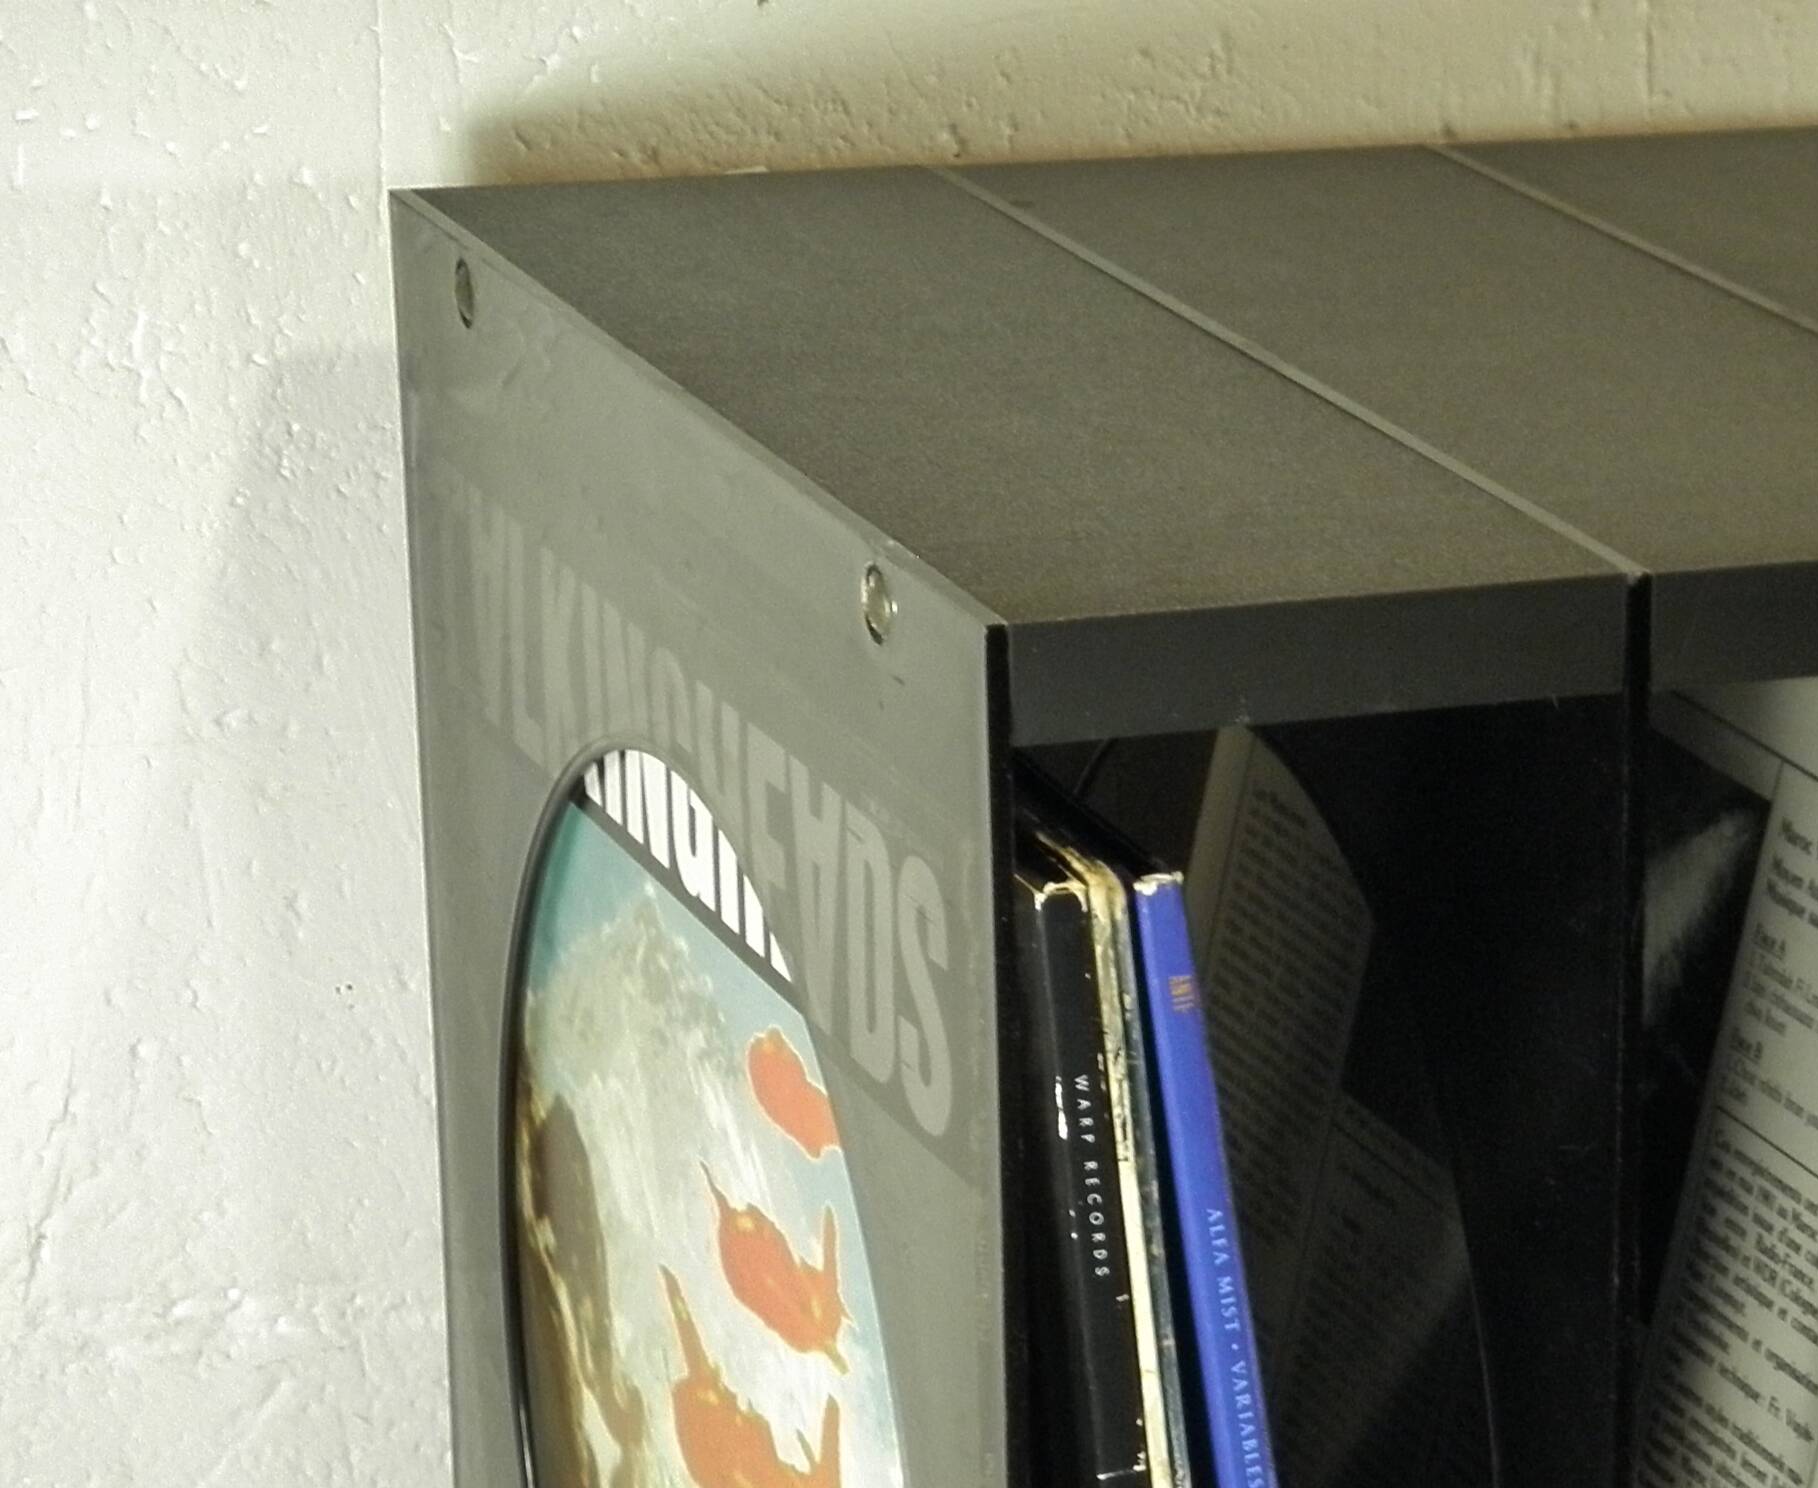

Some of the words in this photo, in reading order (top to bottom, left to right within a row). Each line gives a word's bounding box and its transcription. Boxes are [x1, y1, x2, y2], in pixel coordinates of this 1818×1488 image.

[1074, 1074, 1095, 1146] WARP
[1083, 1159, 1111, 1280] RECORDS
[1204, 1206, 1229, 1267] ALFA
[1215, 1276, 1241, 1334] MIST
